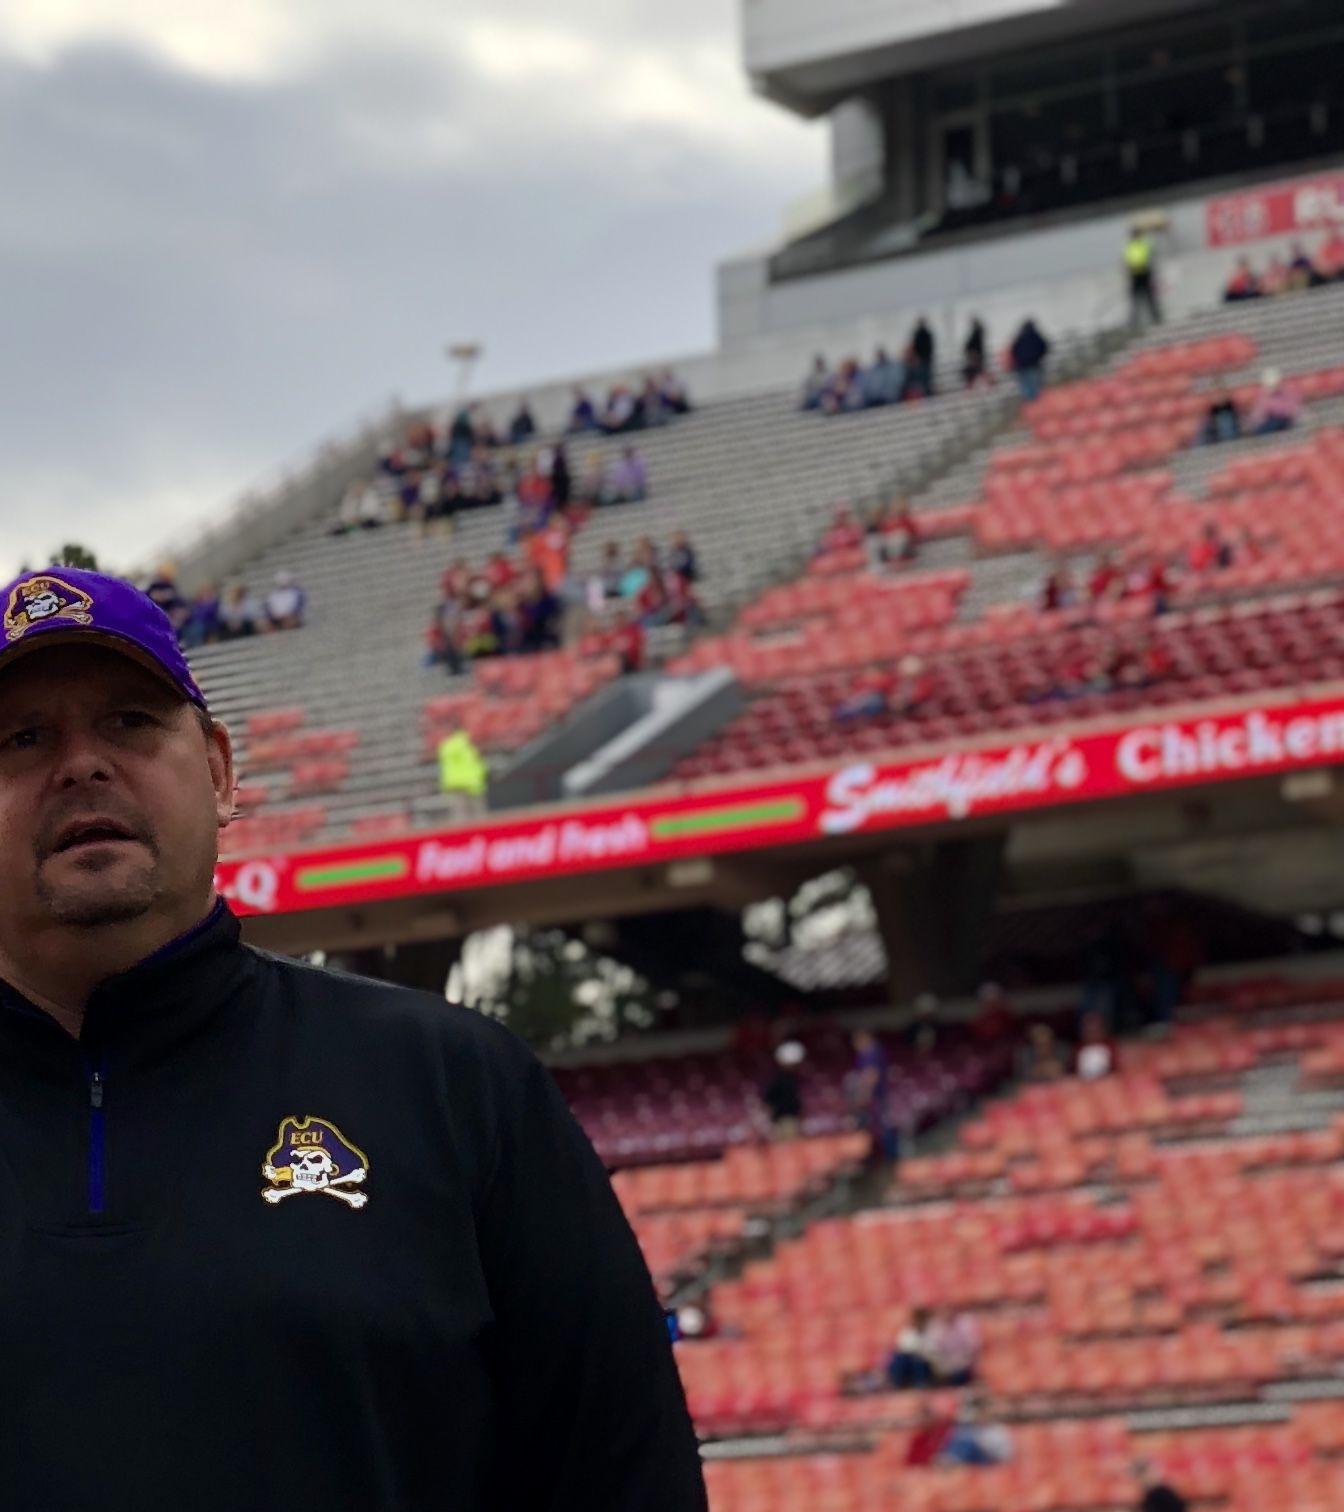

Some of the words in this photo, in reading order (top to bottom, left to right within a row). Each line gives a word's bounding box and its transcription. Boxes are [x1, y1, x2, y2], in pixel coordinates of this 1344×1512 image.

[820, 738, 1086, 834] Smithfield's
[487, 824, 557, 872] and
[290, 1131, 323, 1145] ECU
